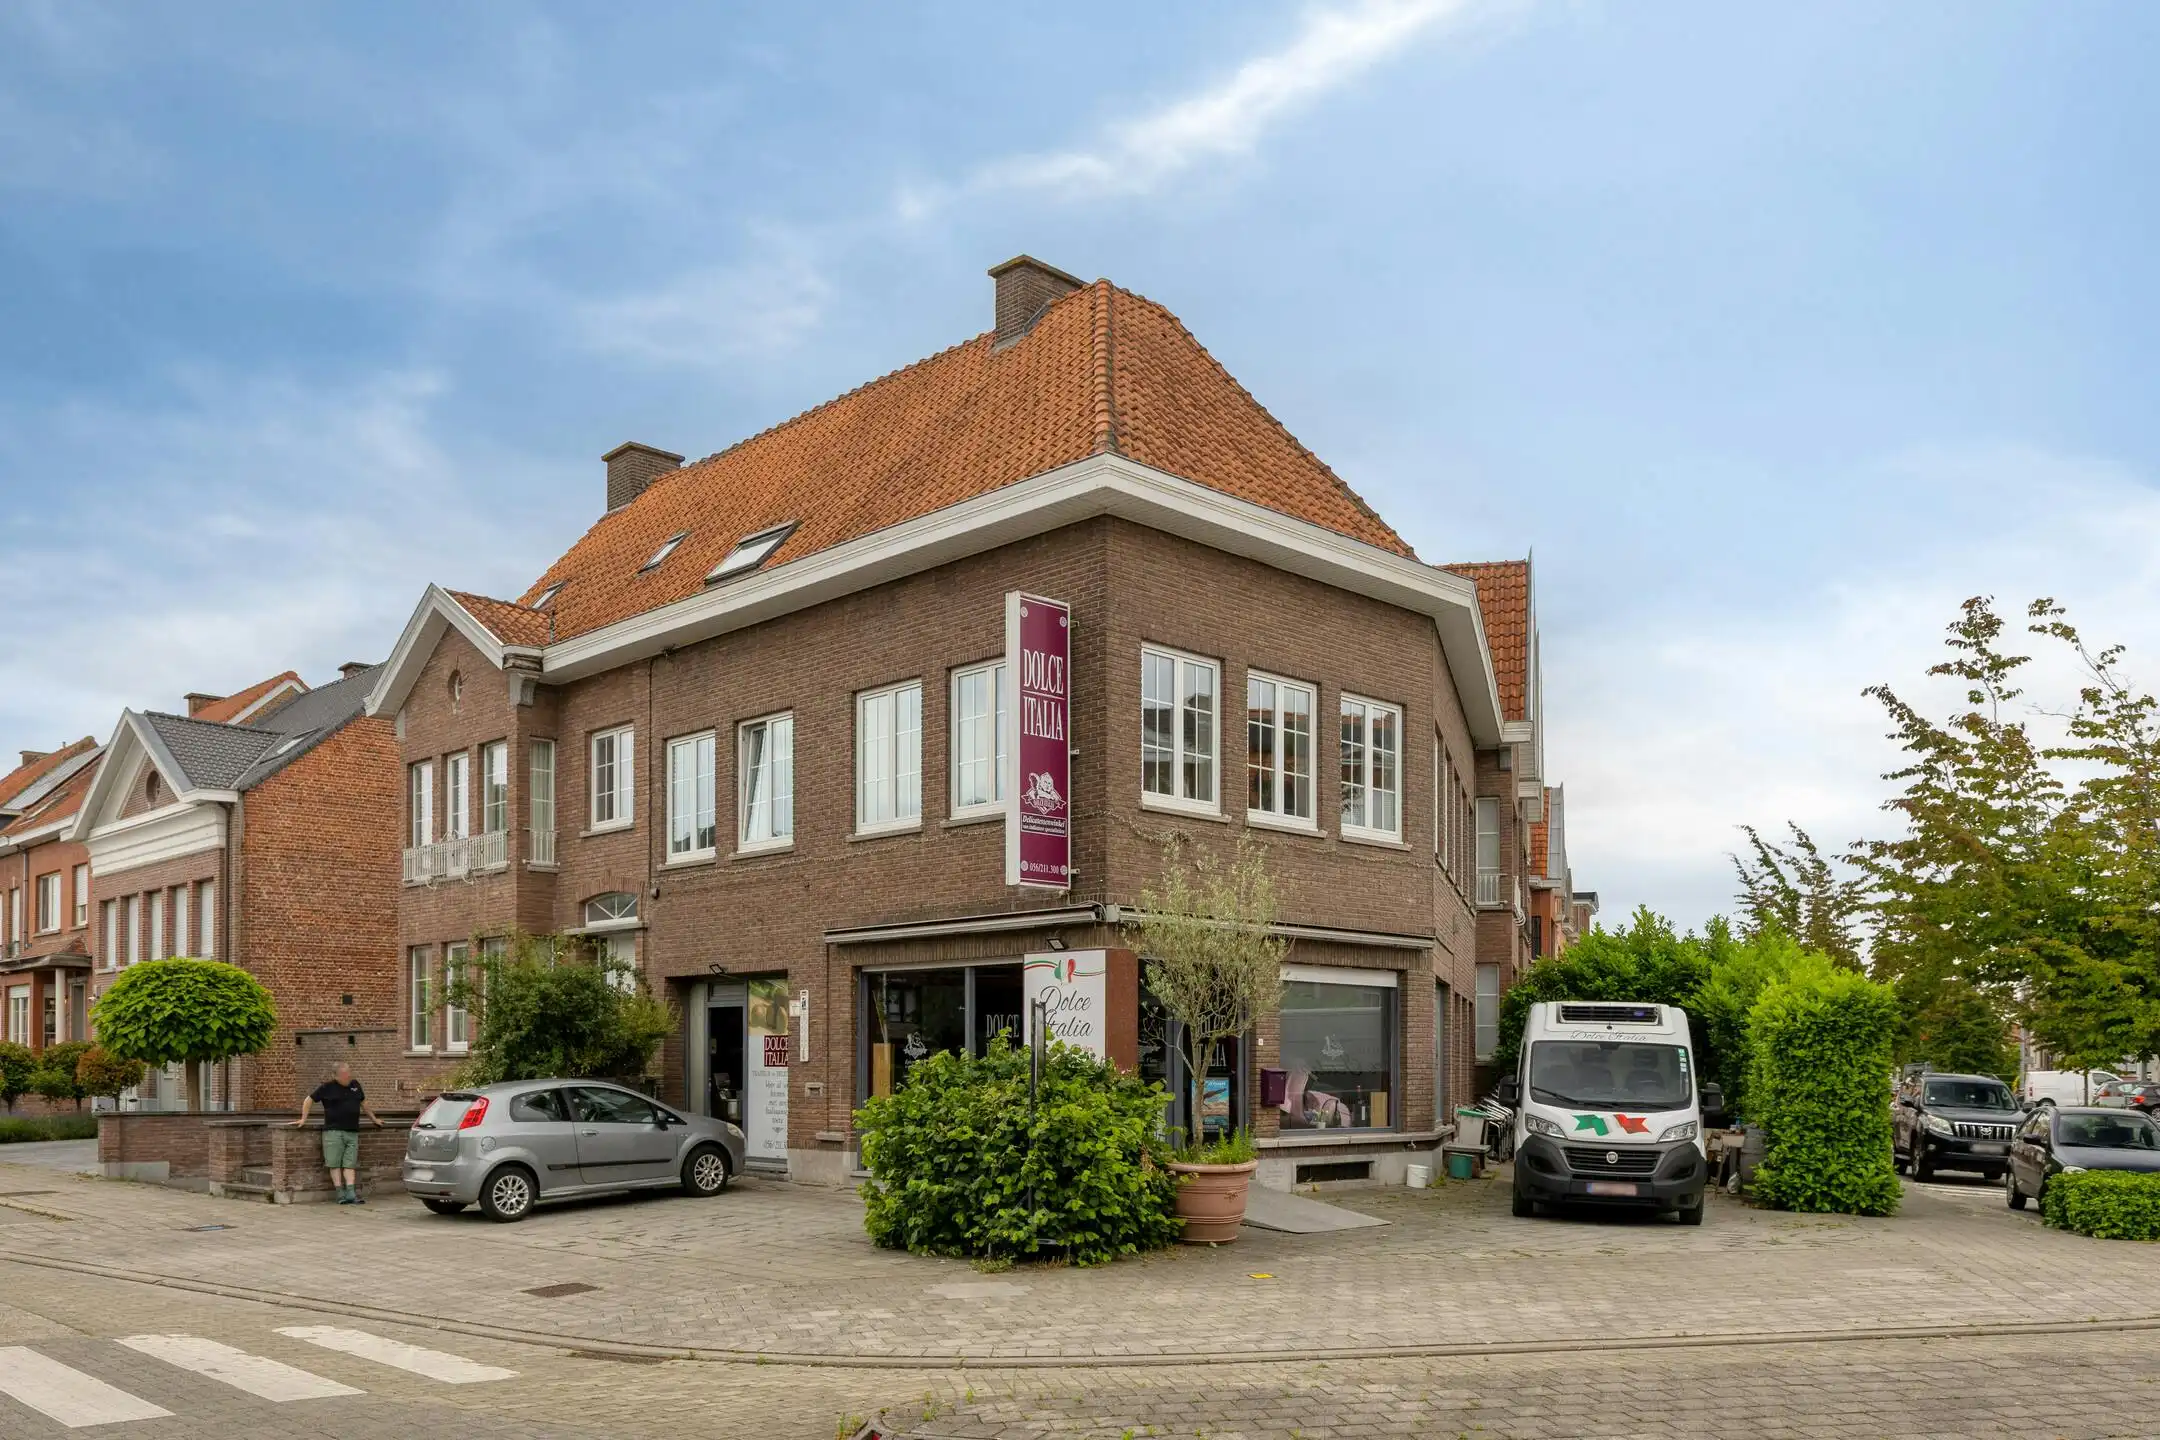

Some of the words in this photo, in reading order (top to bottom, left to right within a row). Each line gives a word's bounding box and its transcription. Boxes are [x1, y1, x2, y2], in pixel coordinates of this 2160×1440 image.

[1023, 648, 1064, 695] DOLCE
[1023, 695, 1064, 741] ITALIA
[1040, 985, 1091, 1011] Dolce
[1045, 1009, 1093, 1037] Italia
[765, 1051, 788, 1066] ITALIA
